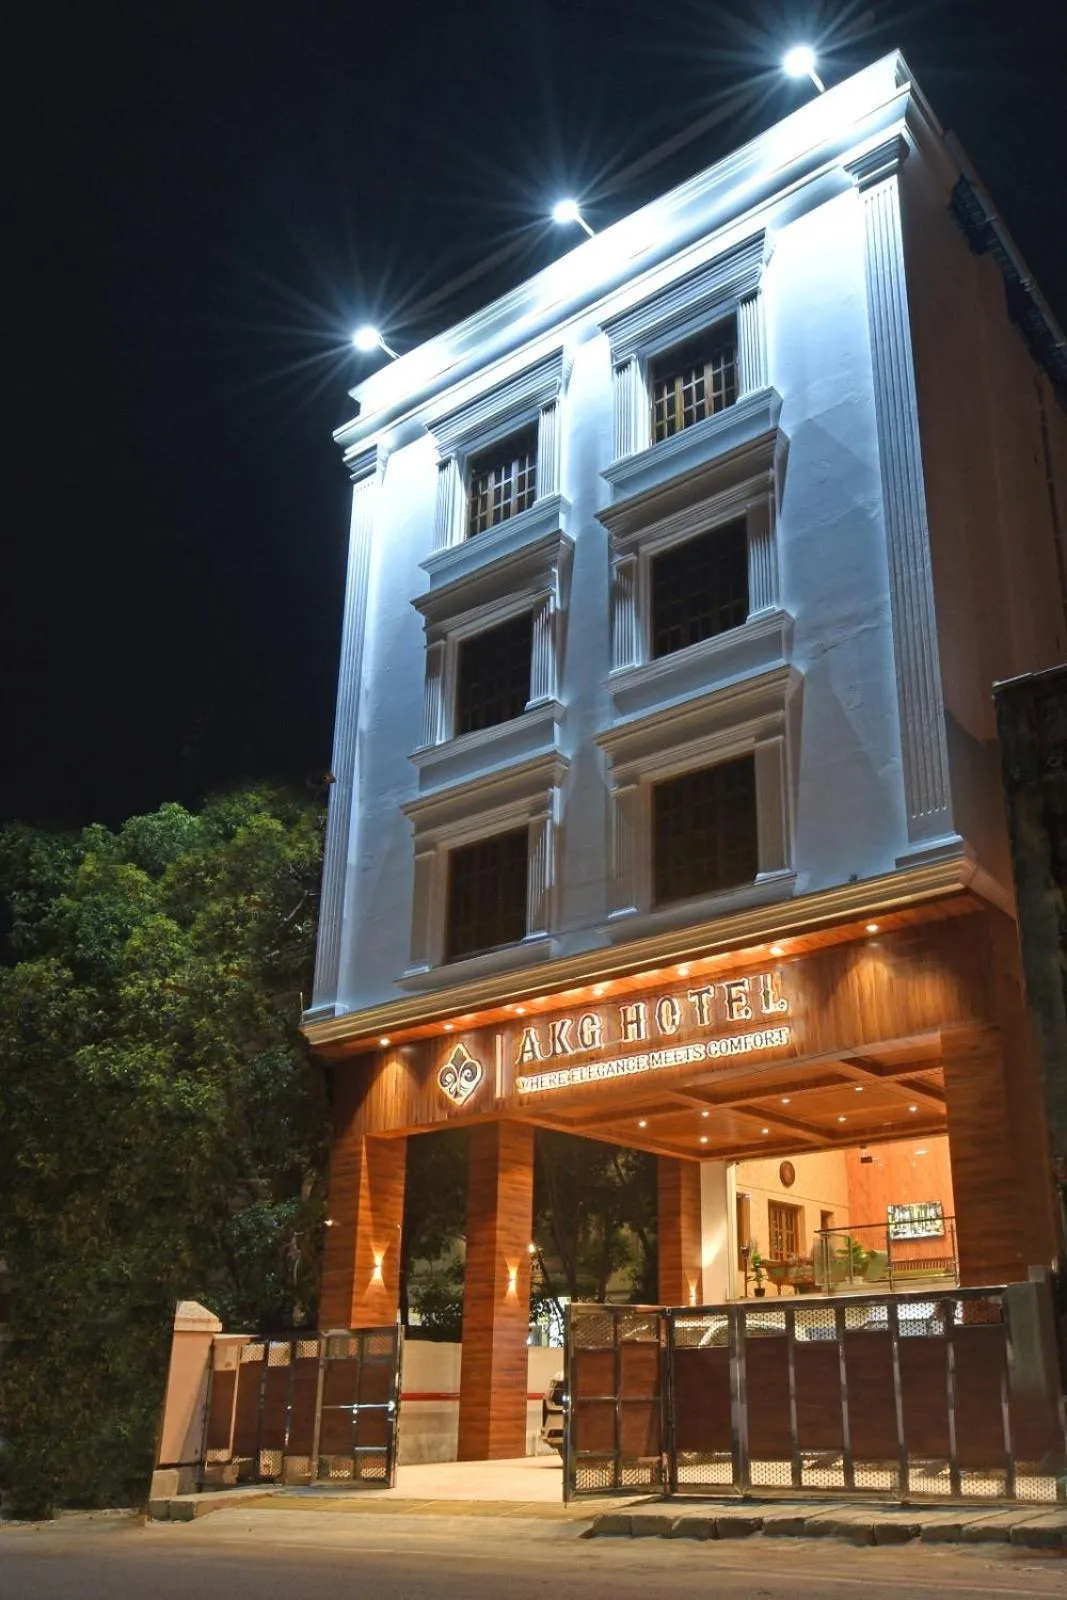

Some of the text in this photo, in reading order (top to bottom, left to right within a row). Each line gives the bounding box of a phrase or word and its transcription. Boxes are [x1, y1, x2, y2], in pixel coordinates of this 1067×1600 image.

[515, 973, 787, 1063] AKG HOTEL
[570, 1054, 649, 1083] ELEGANCE
[650, 1044, 706, 1068] MEETS
[706, 1027, 790, 1057] COMFORT
